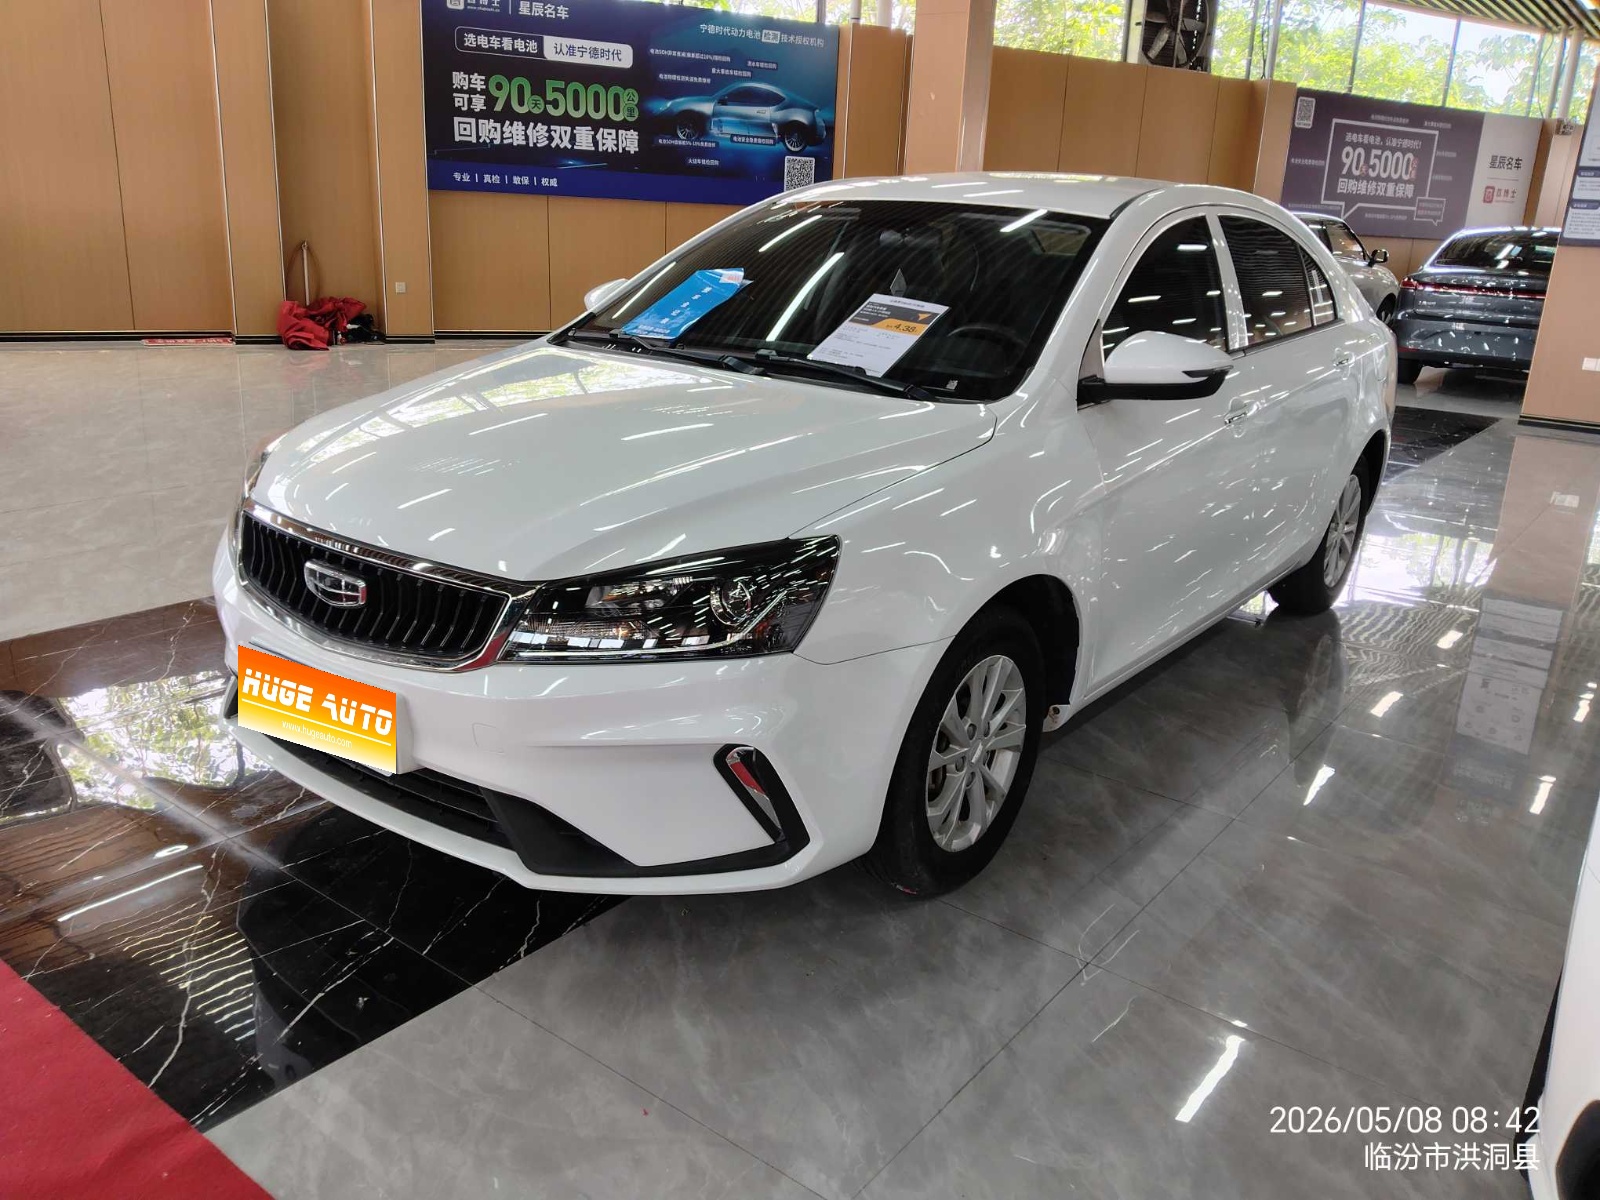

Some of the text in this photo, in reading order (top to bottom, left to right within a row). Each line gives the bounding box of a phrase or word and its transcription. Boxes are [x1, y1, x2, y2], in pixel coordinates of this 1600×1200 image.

[518, 1, 569, 20] 星辰名车
[463, 32, 622, 62] 选电车看电池 认准宁德时代
[452, 71, 486, 91] 购车
[452, 92, 487, 112] 可享
[453, 116, 639, 154] 回购维修双重保障
[1489, 155, 1523, 170] 星辰名车
[453, 172, 558, 187] 专业 真检 敢保 权威
[1337, 177, 1415, 198] 回购维修双重保障
